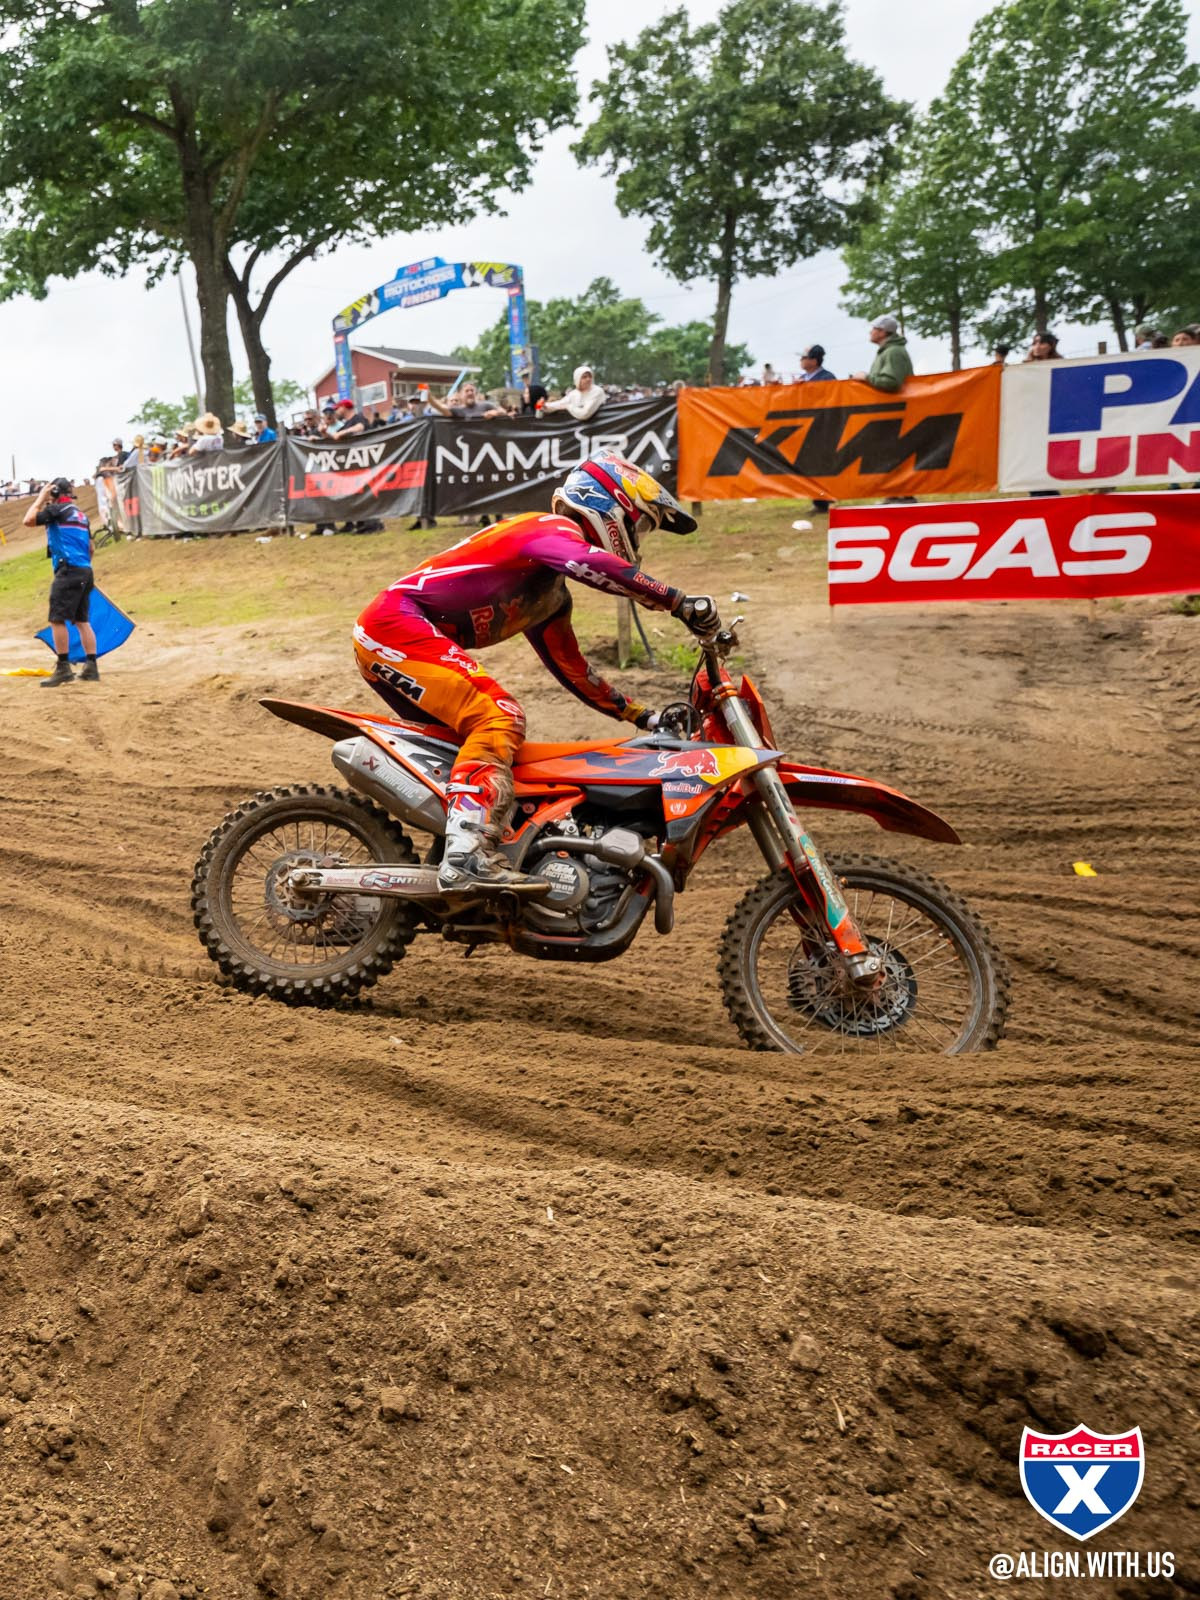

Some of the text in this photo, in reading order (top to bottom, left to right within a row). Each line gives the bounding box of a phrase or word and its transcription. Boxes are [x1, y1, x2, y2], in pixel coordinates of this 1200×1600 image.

[435, 429, 671, 475] NAMURA
[708, 402, 963, 477] KTM
[167, 463, 246, 500] MONSTER
[828, 512, 1157, 584] SGAS
[369, 662, 426, 704] KTM
